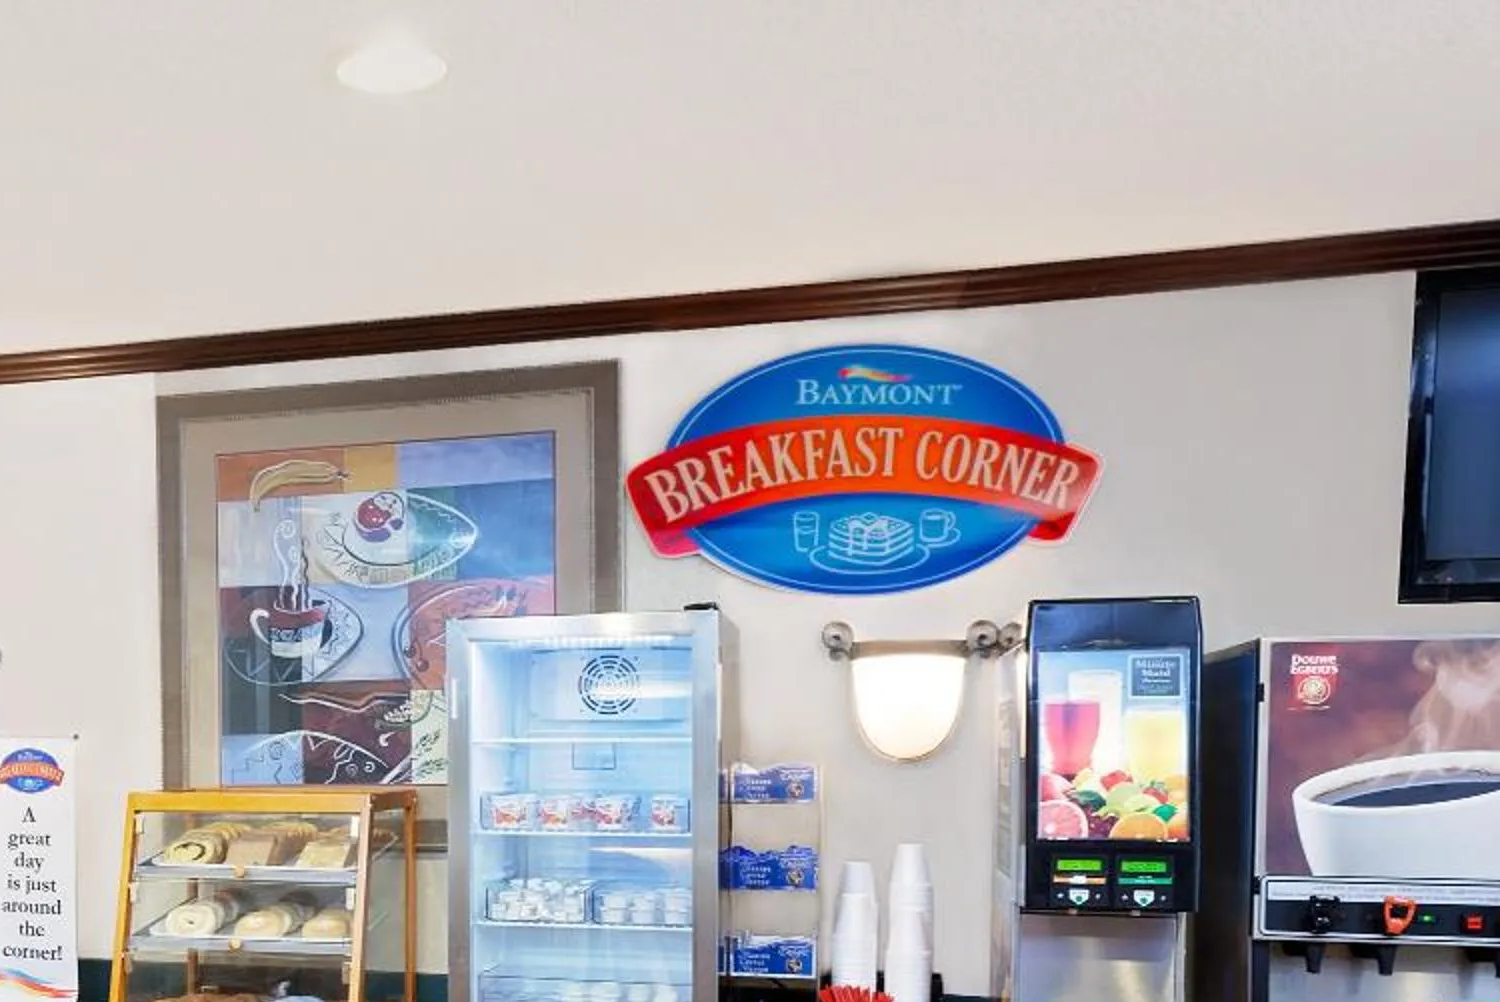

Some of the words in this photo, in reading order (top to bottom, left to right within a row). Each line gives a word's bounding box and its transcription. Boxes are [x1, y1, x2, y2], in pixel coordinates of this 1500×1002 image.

[796, 378, 956, 406] BAYMONT
[643, 425, 905, 524] BREAKFAST
[914, 429, 1082, 510] CORNER
[21, 806, 37, 824] A
[7, 833, 52, 850] great
[13, 852, 45, 874] day
[7, 874, 21, 891] is
[25, 876, 57, 895] just
[2, 899, 62, 916] around
[18, 922, 45, 938] the
[2, 945, 64, 961] corner!
